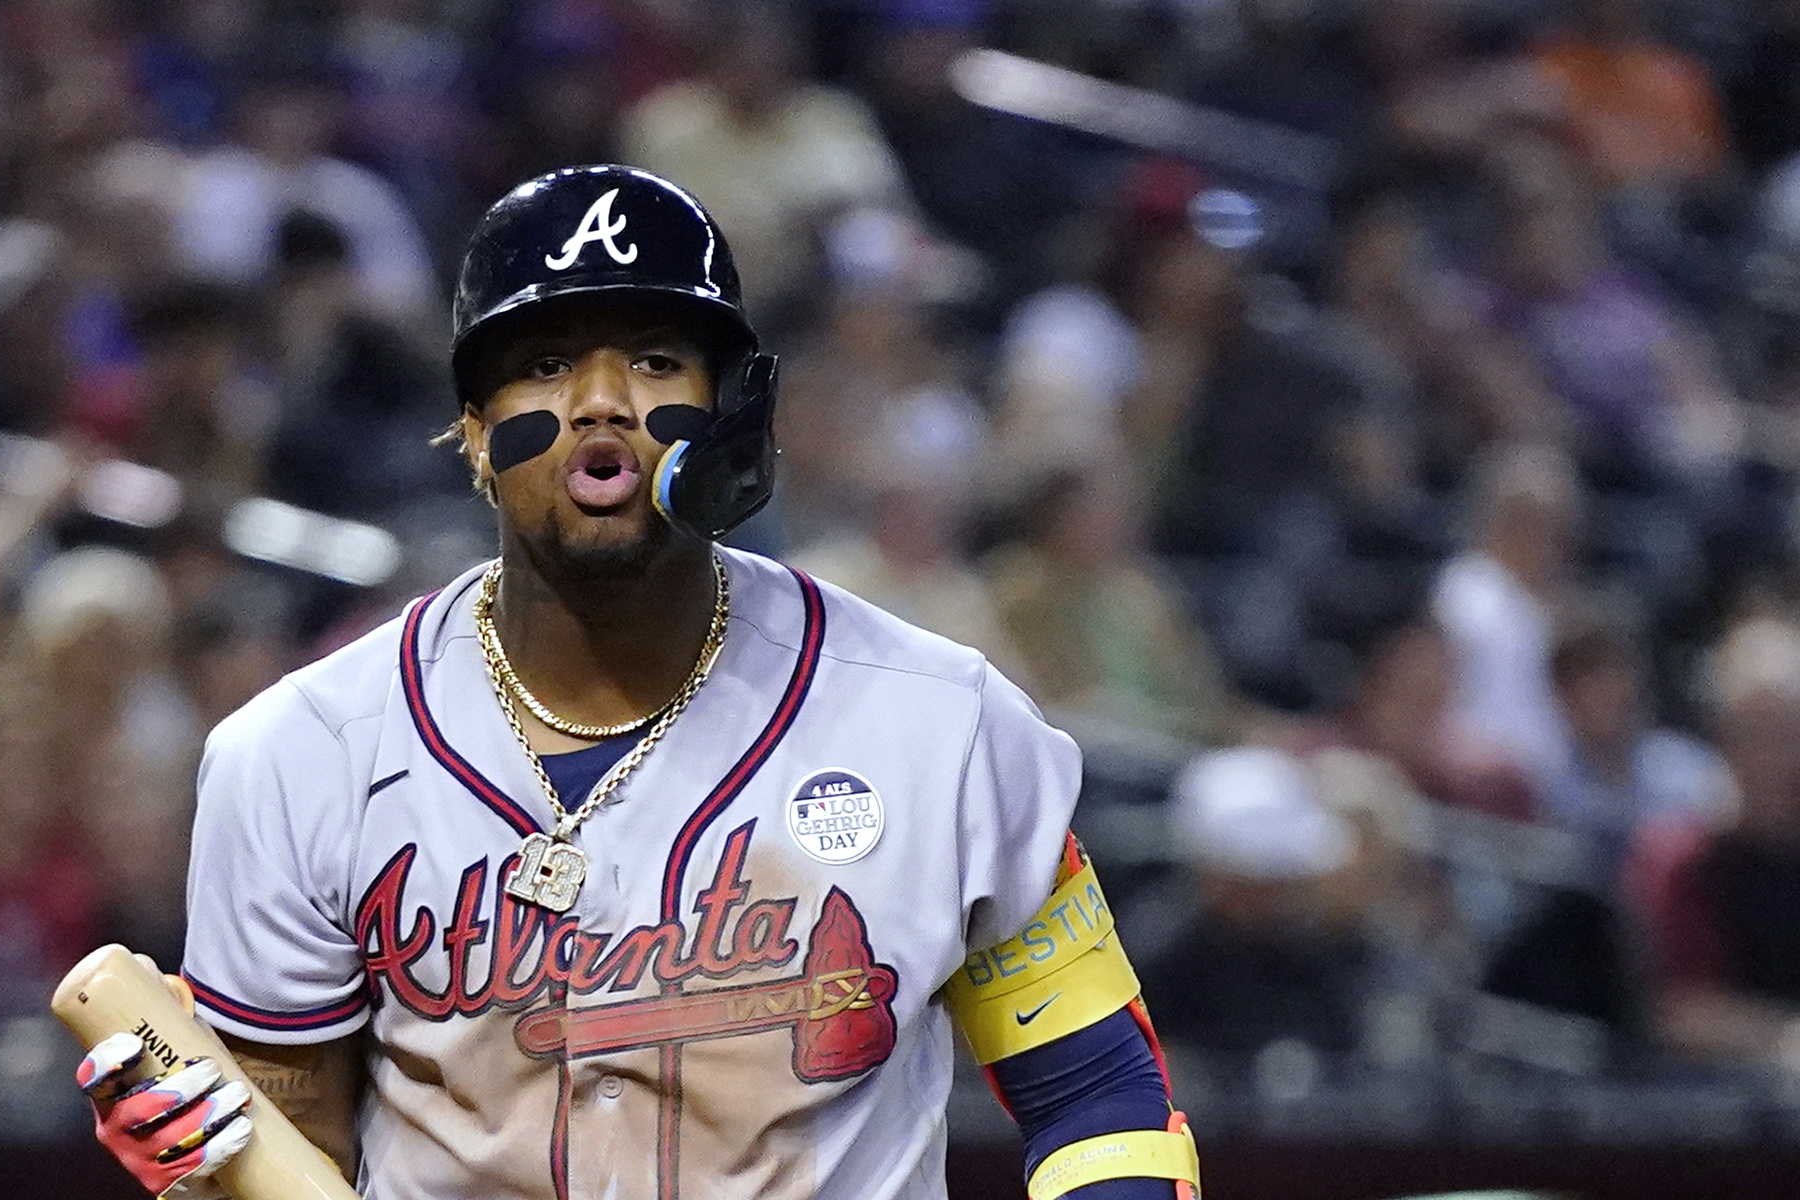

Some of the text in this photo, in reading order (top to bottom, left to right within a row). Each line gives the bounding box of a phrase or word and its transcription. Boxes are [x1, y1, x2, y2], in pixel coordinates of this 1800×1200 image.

[544, 186, 638, 271] A
[824, 781, 853, 796] ALS
[828, 796, 871, 815] LOU
[795, 813, 878, 836] GEHRIG
[818, 831, 859, 851] DAY
[503, 832, 587, 912] 13
[354, 817, 802, 1022] Atlanta
[966, 883, 1108, 986] BESTIA
[131, 1017, 180, 1074] RIME
